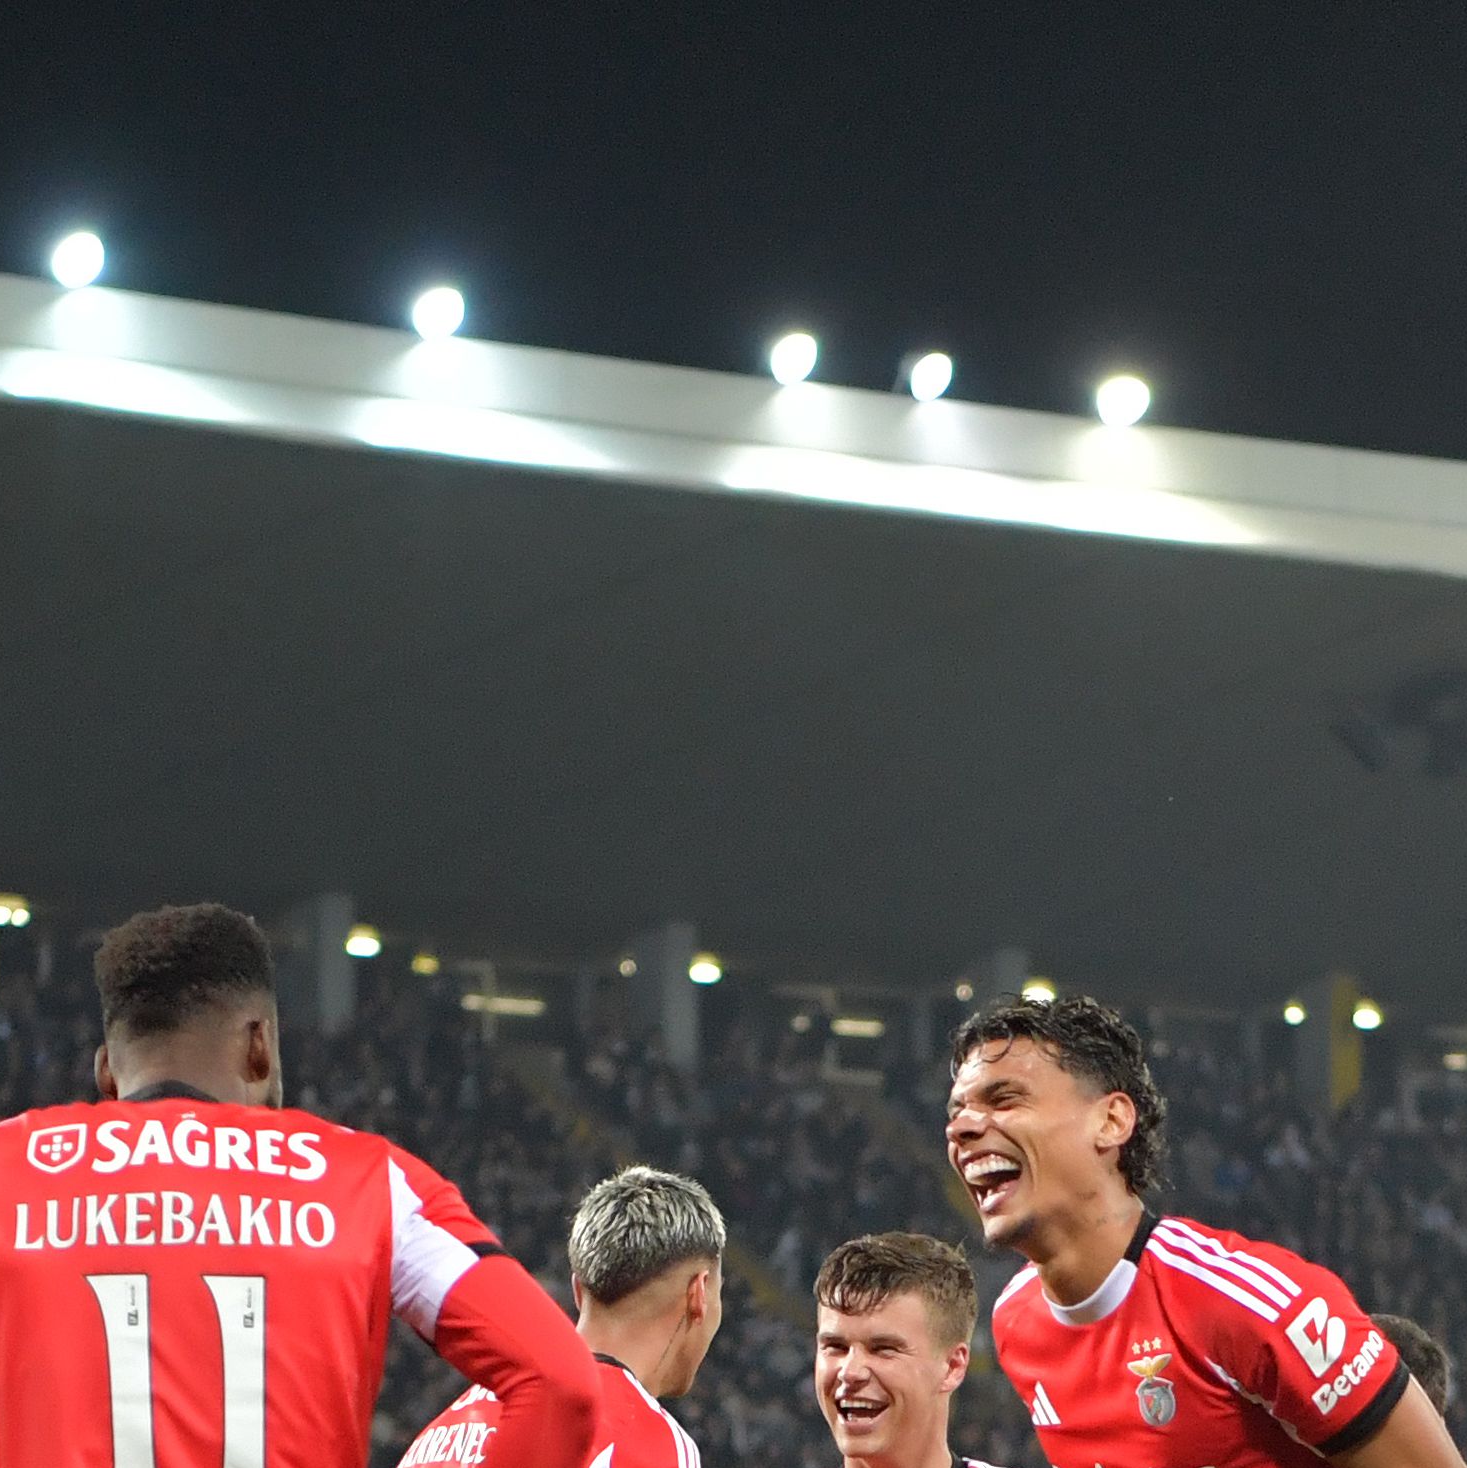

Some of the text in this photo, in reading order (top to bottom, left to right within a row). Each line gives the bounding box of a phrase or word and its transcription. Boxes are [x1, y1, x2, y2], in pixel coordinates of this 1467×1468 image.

[91, 1112, 328, 1182] SAGRES
[13, 1190, 336, 1251] LUKEBAKIO
[1311, 1329, 1384, 1416] Betano
